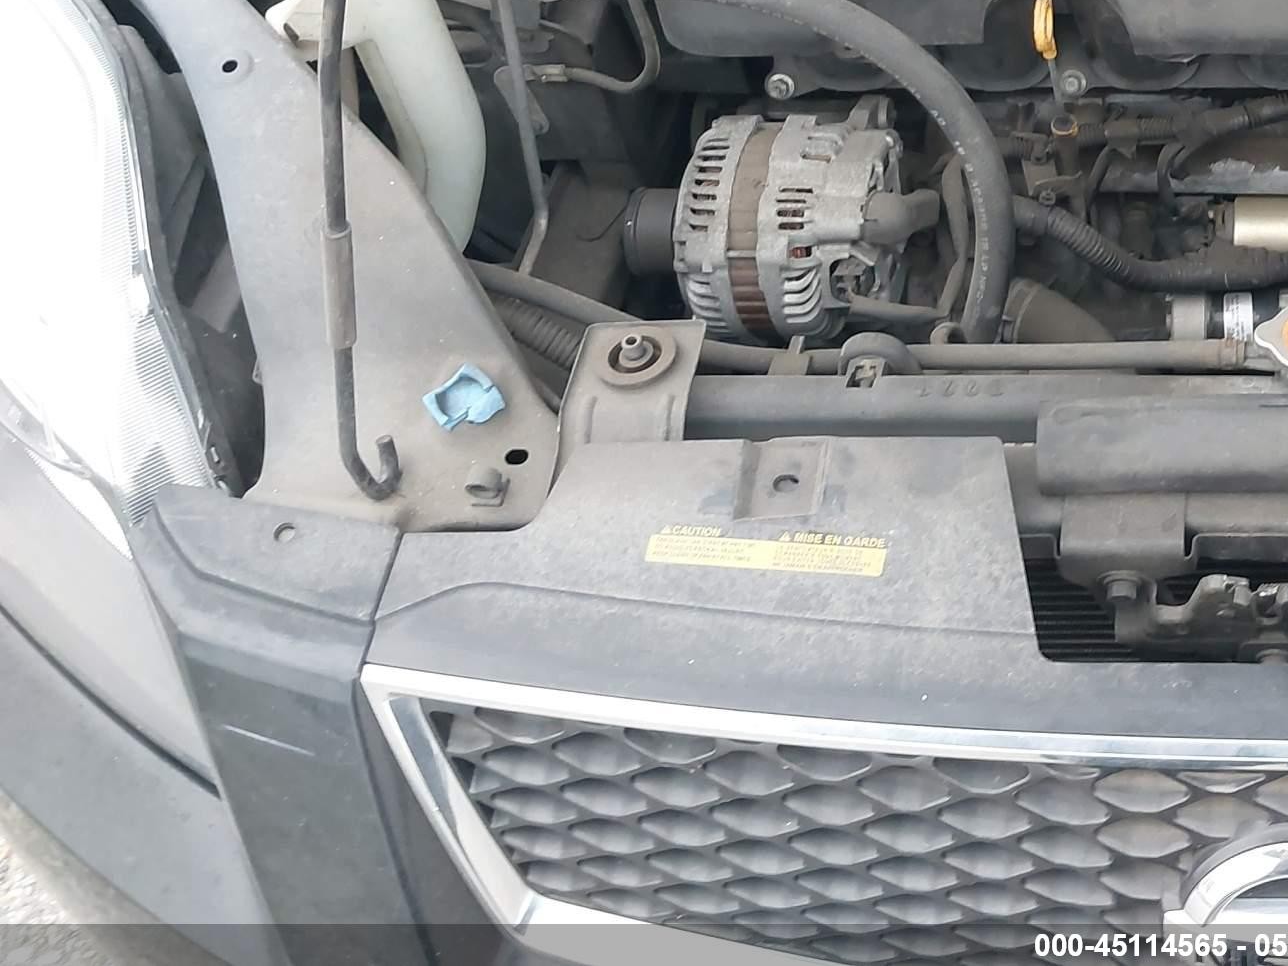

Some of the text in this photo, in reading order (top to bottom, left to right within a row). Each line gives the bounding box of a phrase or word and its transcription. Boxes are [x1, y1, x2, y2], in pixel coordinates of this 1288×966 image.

[672, 524, 722, 538] CAUTION
[793, 532, 886, 549] MISE EN GARDE
